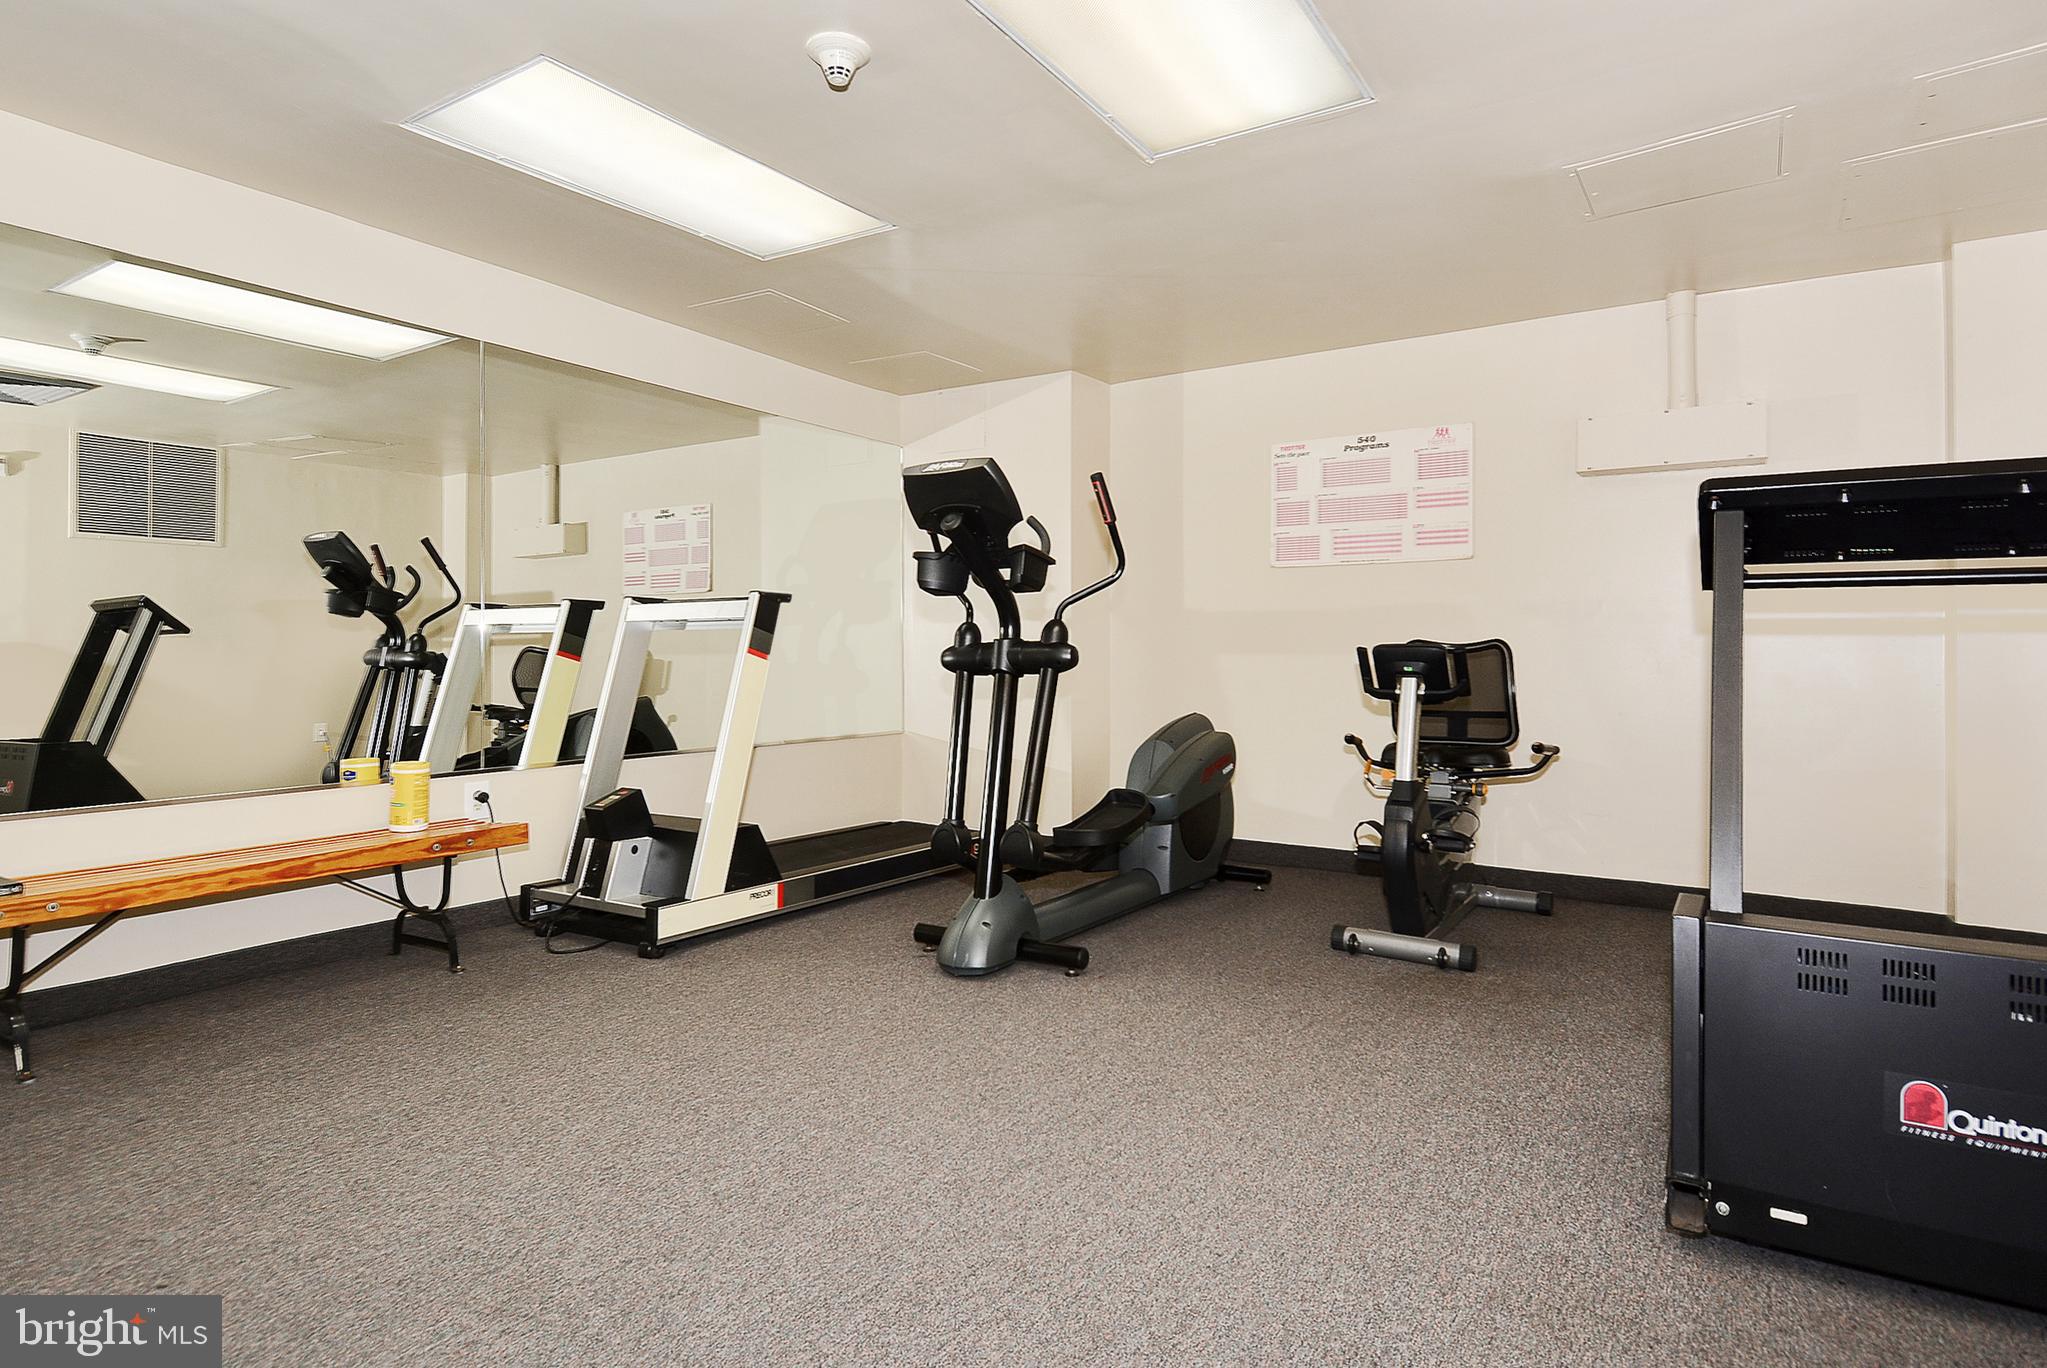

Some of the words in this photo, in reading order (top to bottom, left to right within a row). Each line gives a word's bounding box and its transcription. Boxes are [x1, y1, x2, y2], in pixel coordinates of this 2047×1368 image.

[1344, 442, 1390, 452] Programs
[1357, 435, 1376, 444] 540
[1948, 1110, 2047, 1145] Quinton
[1901, 1125, 1955, 1142] FITNESS
[1966, 1138, 2047, 1159] EQUIPMENT
